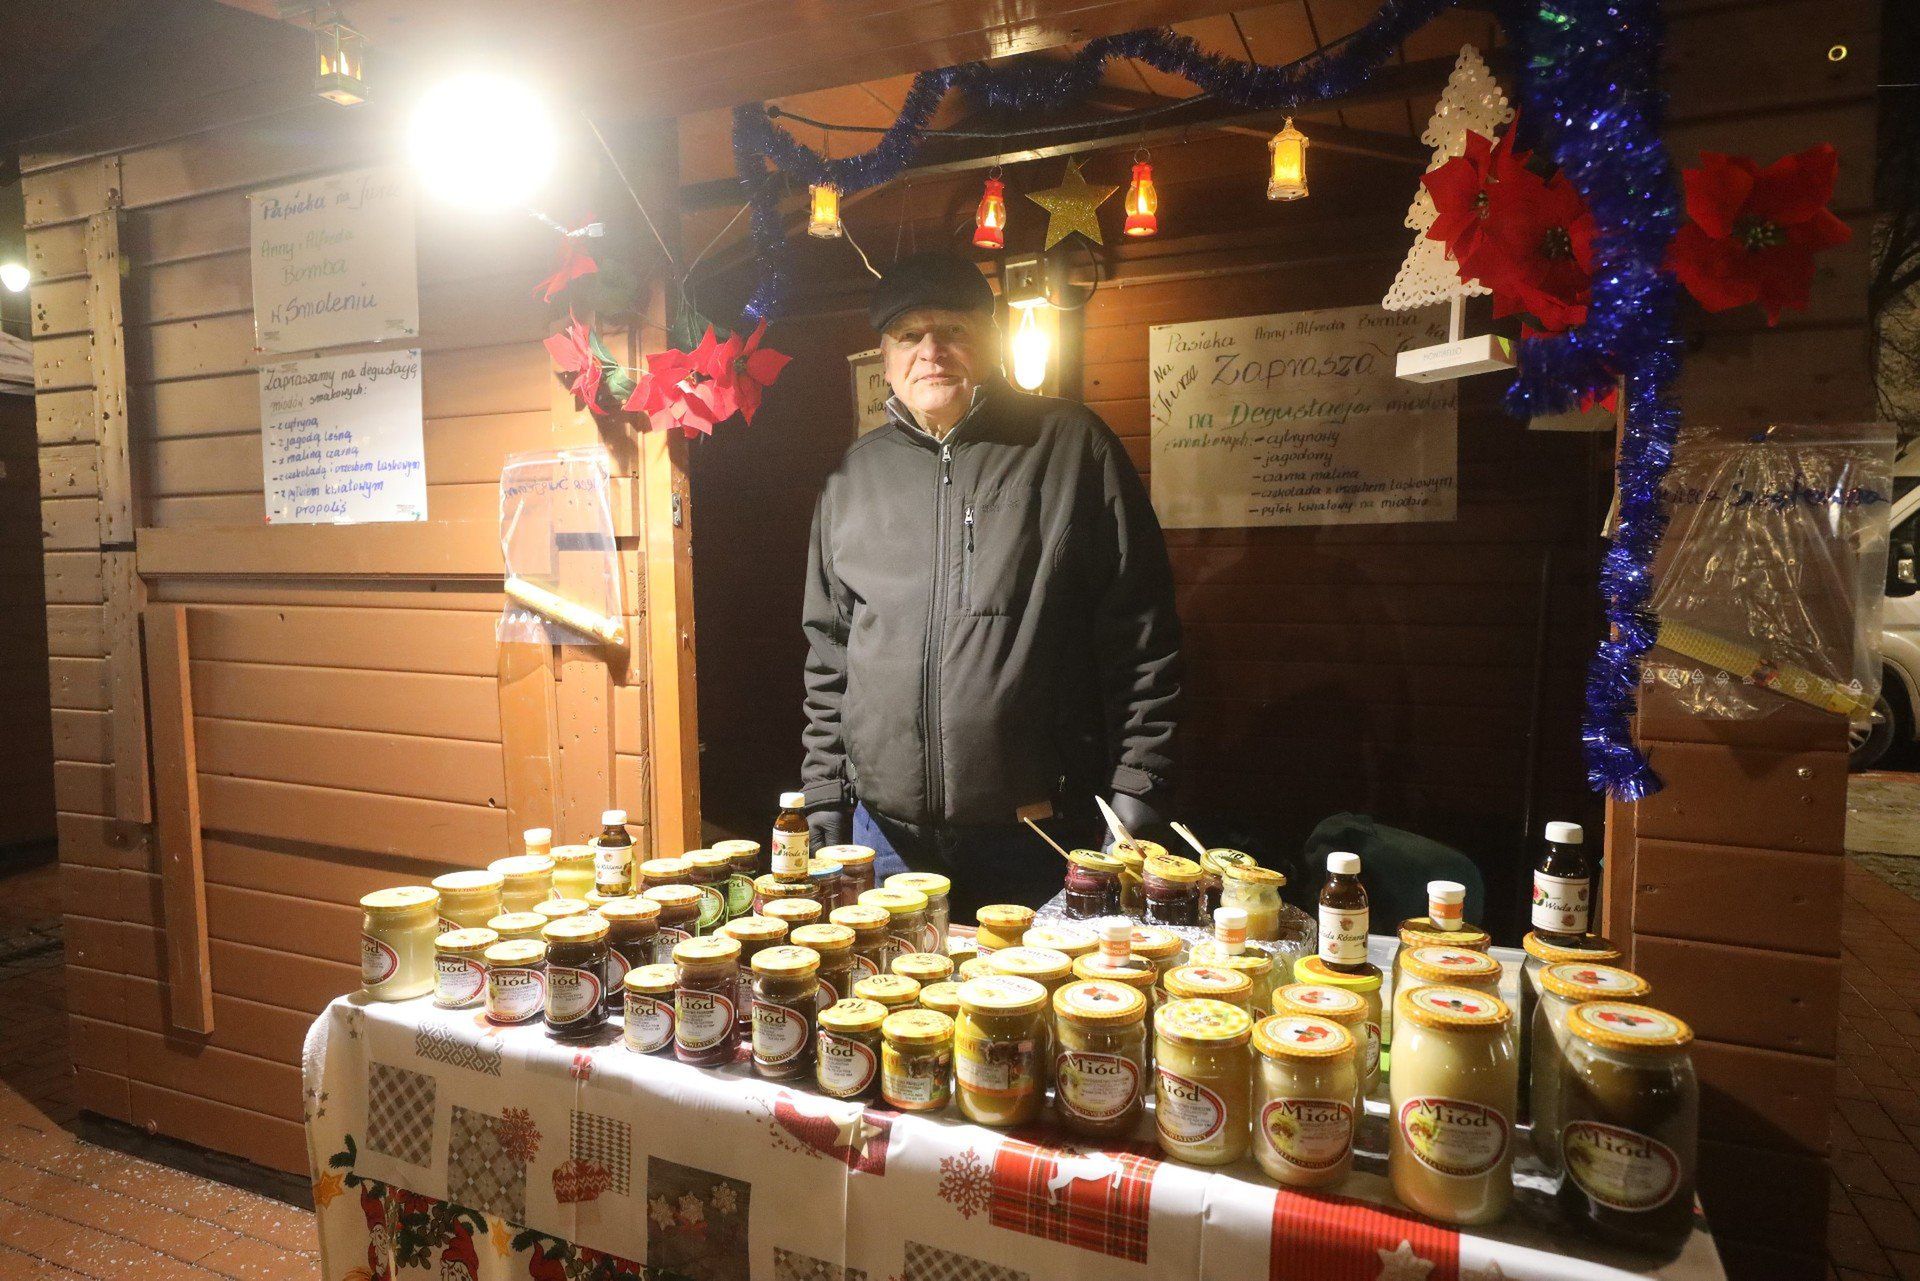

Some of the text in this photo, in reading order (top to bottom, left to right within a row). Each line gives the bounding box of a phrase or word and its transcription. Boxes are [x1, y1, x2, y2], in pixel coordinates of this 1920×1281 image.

[1167, 331, 1236, 353] Pasieka
[264, 368, 336, 391] Zapraszamy
[341, 370, 356, 381] na
[1210, 352, 1377, 390] Zaprasza
[1188, 413, 1214, 429] na
[1545, 901, 1571, 912] Woda
[549, 971, 580, 986] iód
[1067, 1054, 1121, 1075] Miód
[1279, 1101, 1341, 1122] Miód
[1420, 1100, 1489, 1127] Miód
[1579, 1128, 1651, 1158] Miód
